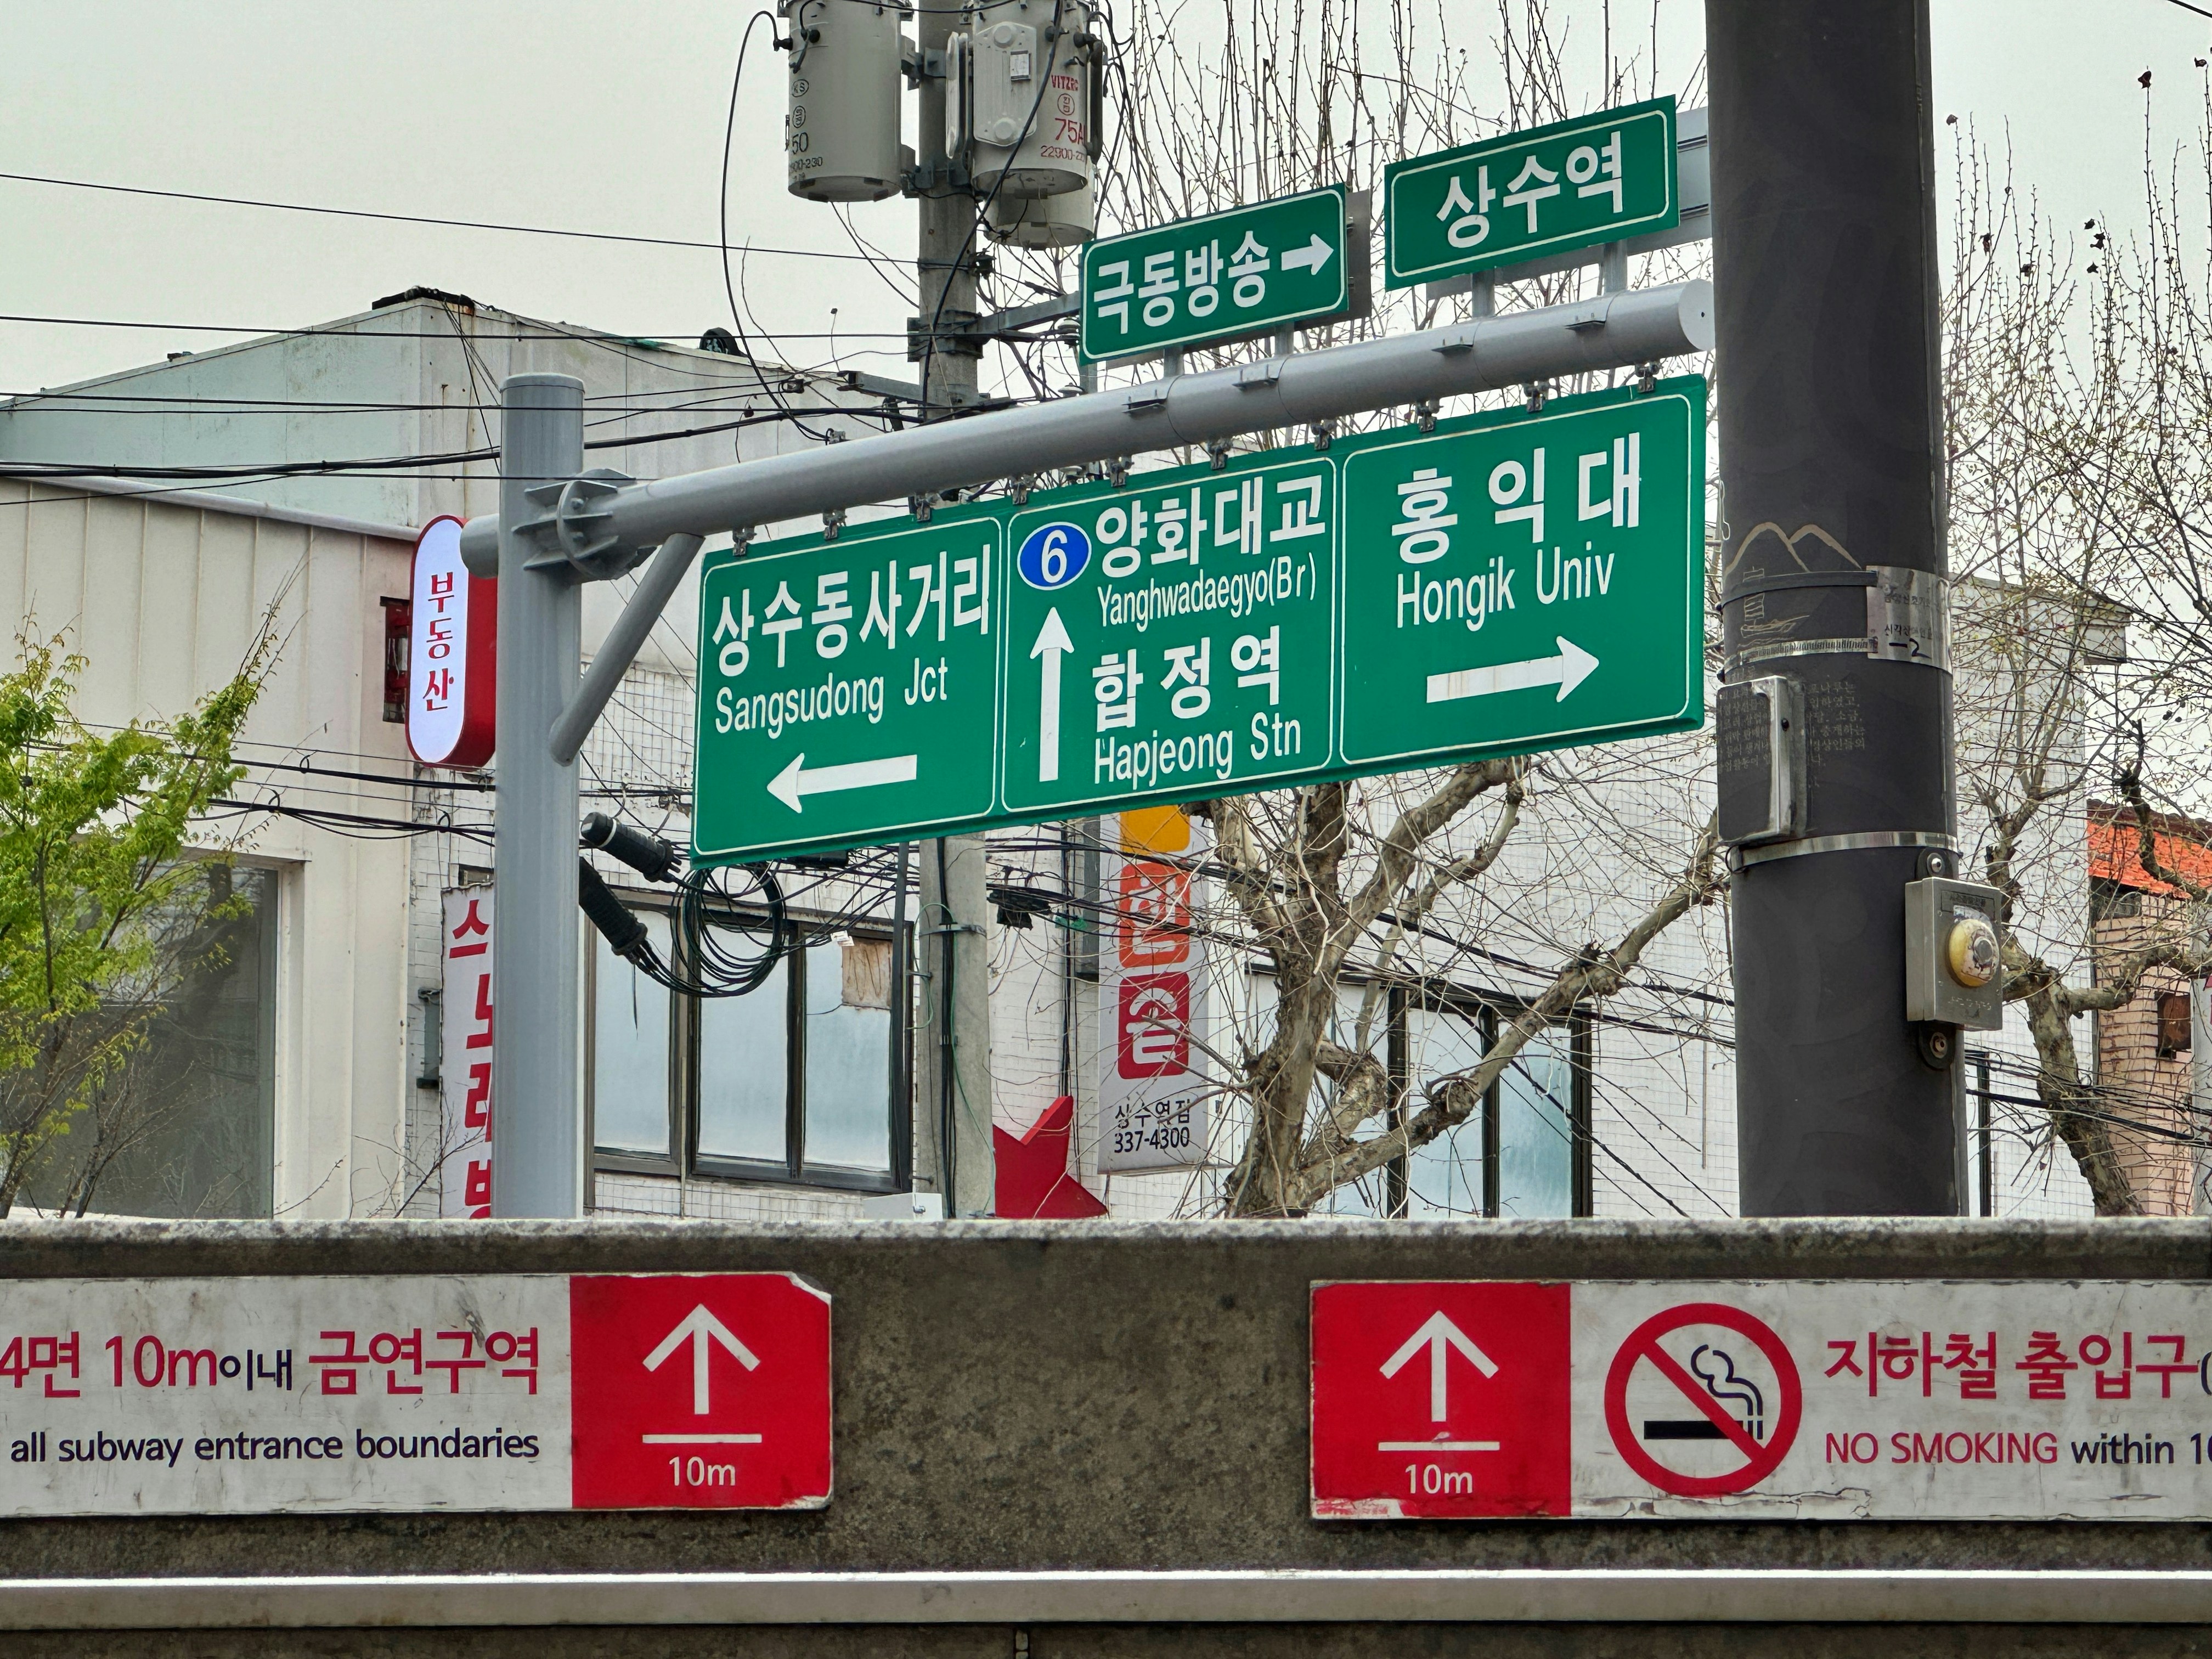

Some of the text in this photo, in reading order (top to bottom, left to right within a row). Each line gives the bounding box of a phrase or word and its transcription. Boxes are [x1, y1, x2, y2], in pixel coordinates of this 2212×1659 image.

[1436, 130, 1624, 249] 상수역
[1094, 229, 1270, 335] 극동방송
[1096, 475, 1325, 578] 양화대교
[1392, 432, 1640, 563] 홍익대
[1042, 530, 1068, 584] 6
[1097, 552, 1316, 632] Yanghwadaegyo(Br)
[1397, 541, 1615, 631] Hongik Univ
[423, 572, 454, 711] 부동산
[713, 544, 990, 677] 상수동사거리
[715, 657, 947, 739] Sangsudong Jct
[1092, 625, 1279, 732] 합정역
[1094, 712, 1300, 789] Hapjeong Stn
[1114, 1126, 1190, 1153] 337-4300
[0, 1331, 80, 1397] 4면
[309, 1328, 538, 1395] 금연구역
[1825, 1331, 1997, 1400] 지하철
[11, 1427, 539, 1468] all subway entrance boundaries
[669, 1457, 736, 1486] 10m
[1405, 1464, 1474, 1494] 10m
[1826, 1432, 1879, 1464] NO
[1891, 1432, 2058, 1464] SMOKING
[2070, 1432, 2174, 1464] within
